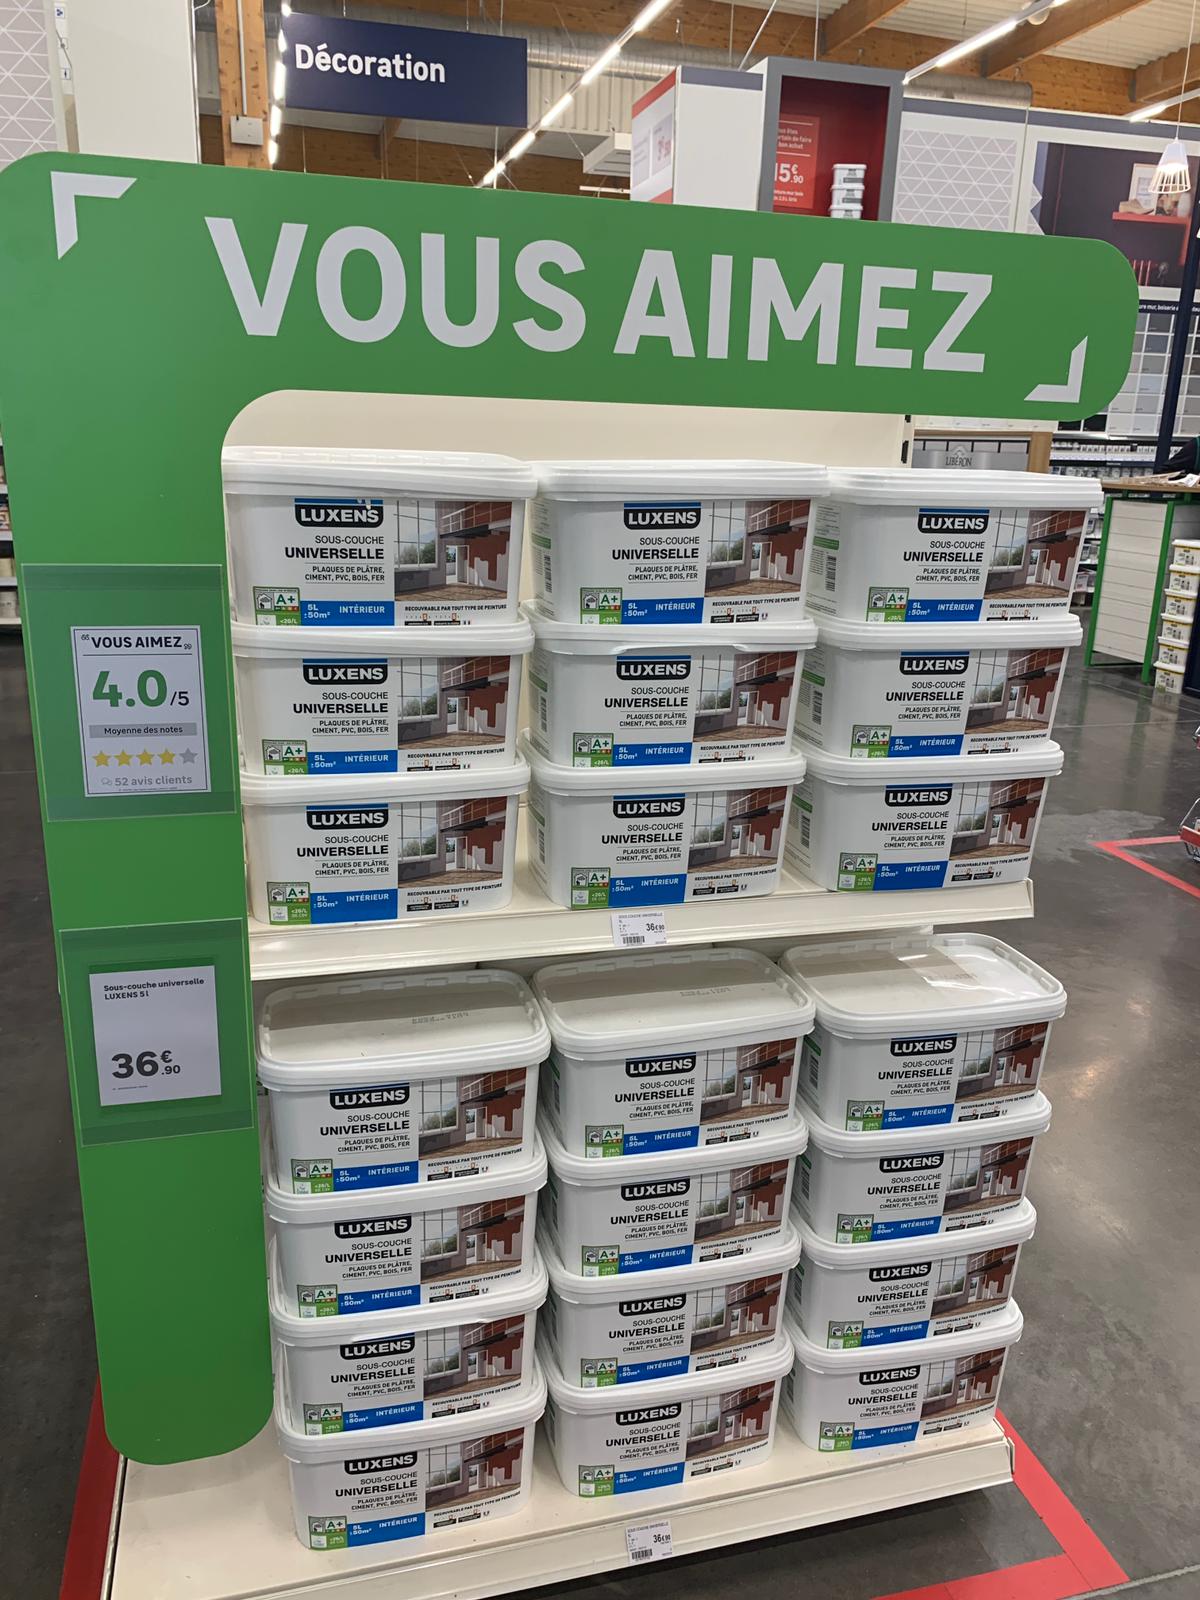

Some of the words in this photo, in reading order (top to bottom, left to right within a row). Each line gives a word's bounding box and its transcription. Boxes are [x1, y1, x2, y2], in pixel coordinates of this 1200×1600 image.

[295, 44, 446, 84] Décoration
[204, 216, 586, 352] VOUS
[613, 248, 993, 373] AIMEZ
[946, 454, 972, 467] LIBÉRON
[300, 508, 379, 523] LUXENS
[628, 511, 697, 524] LUXENS
[921, 517, 985, 530] LUXENS
[315, 535, 384, 544] SOUS-COUCHE
[640, 536, 699, 545] SOUS-COUCHE
[285, 547, 384, 559] UNIVERSELLE
[612, 548, 699, 560] UNIVERSELLE
[903, 552, 983, 562] UNIVERSELLE
[312, 566, 345, 574] PLAQUES
[357, 565, 384, 574] PLÂTRE,
[277, 593, 295, 605] A+
[601, 595, 618, 604] A+
[888, 593, 904, 603] A+
[339, 606, 385, 614] INTÉRIEUR
[655, 602, 696, 611] INTÉRIEUR
[937, 603, 974, 611] INTÉRIEUR
[621, 664, 687, 676] LUXENS
[903, 659, 965, 671] LUXENS
[308, 667, 384, 681] LUXENS
[886, 691, 964, 701] UNIVERSELLE
[293, 703, 388, 714] UNIVERSELLE
[604, 697, 688, 708] UNIVERSELLE
[104, 727, 142, 736] Moyenne
[592, 739, 609, 748] A+
[284, 747, 302, 756] A+
[344, 754, 389, 762] INTÉRIEUR
[115, 778, 128, 786] 52
[131, 776, 153, 786] avis
[155, 775, 192, 785] clients
[889, 791, 949, 803] LUXENS
[617, 801, 681, 814] LUXENS
[311, 812, 384, 826] LUXENS
[627, 823, 684, 831] SOUS-COUCHE
[871, 821, 947, 832] UNIVERSELLE
[324, 835, 389, 844] SOUS-COUCHE
[601, 833, 682, 844] UNIVERSELLE
[297, 845, 389, 857] UNIVERSELLE
[641, 878, 679, 886] INTÉRIEUR
[288, 887, 305, 896] A+
[347, 893, 389, 902] INTÉRIEUR
[104, 982, 157, 992] Sous-couche
[158, 978, 204, 988] universelle
[105, 991, 138, 1000] LUXENS
[894, 1040, 953, 1053] LUXENS
[630, 1058, 693, 1074] LUXENS
[902, 1058, 954, 1068] SOUS-COUCHE
[878, 1067, 952, 1080] UNIVERSELLE
[640, 1078, 695, 1089] SOUS-COUCHE
[334, 1090, 406, 1106] LUXENS
[615, 1088, 694, 1103] UNIVERSELLE
[347, 1110, 410, 1122] SOUS-COUCHE
[912, 1108, 946, 1116] INTÉRIEUR
[320, 1120, 410, 1136] UNIVERSELLE
[655, 1131, 691, 1141] INTÉRIEUR
[311, 1165, 328, 1173] A+
[883, 1156, 941, 1170] LUXENS
[368, 1166, 410, 1176] INTÉRIEUR
[891, 1174, 942, 1184] SOUS-COUCHE
[625, 1182, 687, 1198] LUXENS
[867, 1182, 940, 1195] UNIVERSELLE
[635, 1200, 689, 1212] SOUS-COUCHE
[610, 1209, 689, 1225] UNIVERSELLE
[339, 1219, 408, 1235] LUXENS
[352, 1238, 412, 1250] SOUS-COUCHE
[325, 1248, 412, 1264] UNIVERSELLE
[872, 1264, 929, 1279] LUXENS
[880, 1281, 929, 1292] SOUS-COUCHE
[372, 1289, 412, 1300] INTÉRIEUR
[857, 1289, 928, 1303] UNIVERSELLE
[622, 1297, 683, 1314] LUXENS
[632, 1314, 686, 1326] SOUS-COUCHE
[609, 1322, 685, 1339] UNIVERSELLE
[344, 1340, 412, 1357] LUXENS
[356, 1358, 415, 1370] SOUS-COUCHE
[331, 1366, 415, 1383] UNIVERSELLE
[862, 1368, 918, 1383] LUXENS
[871, 1384, 918, 1395] SOUS-COUCHE
[848, 1391, 918, 1405] UNIVERSELLE
[620, 1406, 678, 1423] LUXENS
[629, 1422, 681, 1435] SOUS-COUCHE
[606, 1430, 680, 1447] UNIVERSELLE
[348, 1454, 414, 1472] LUXENS
[360, 1472, 418, 1484] SOUS-COUCHE
[335, 1480, 418, 1497] UNIVERSELLE
